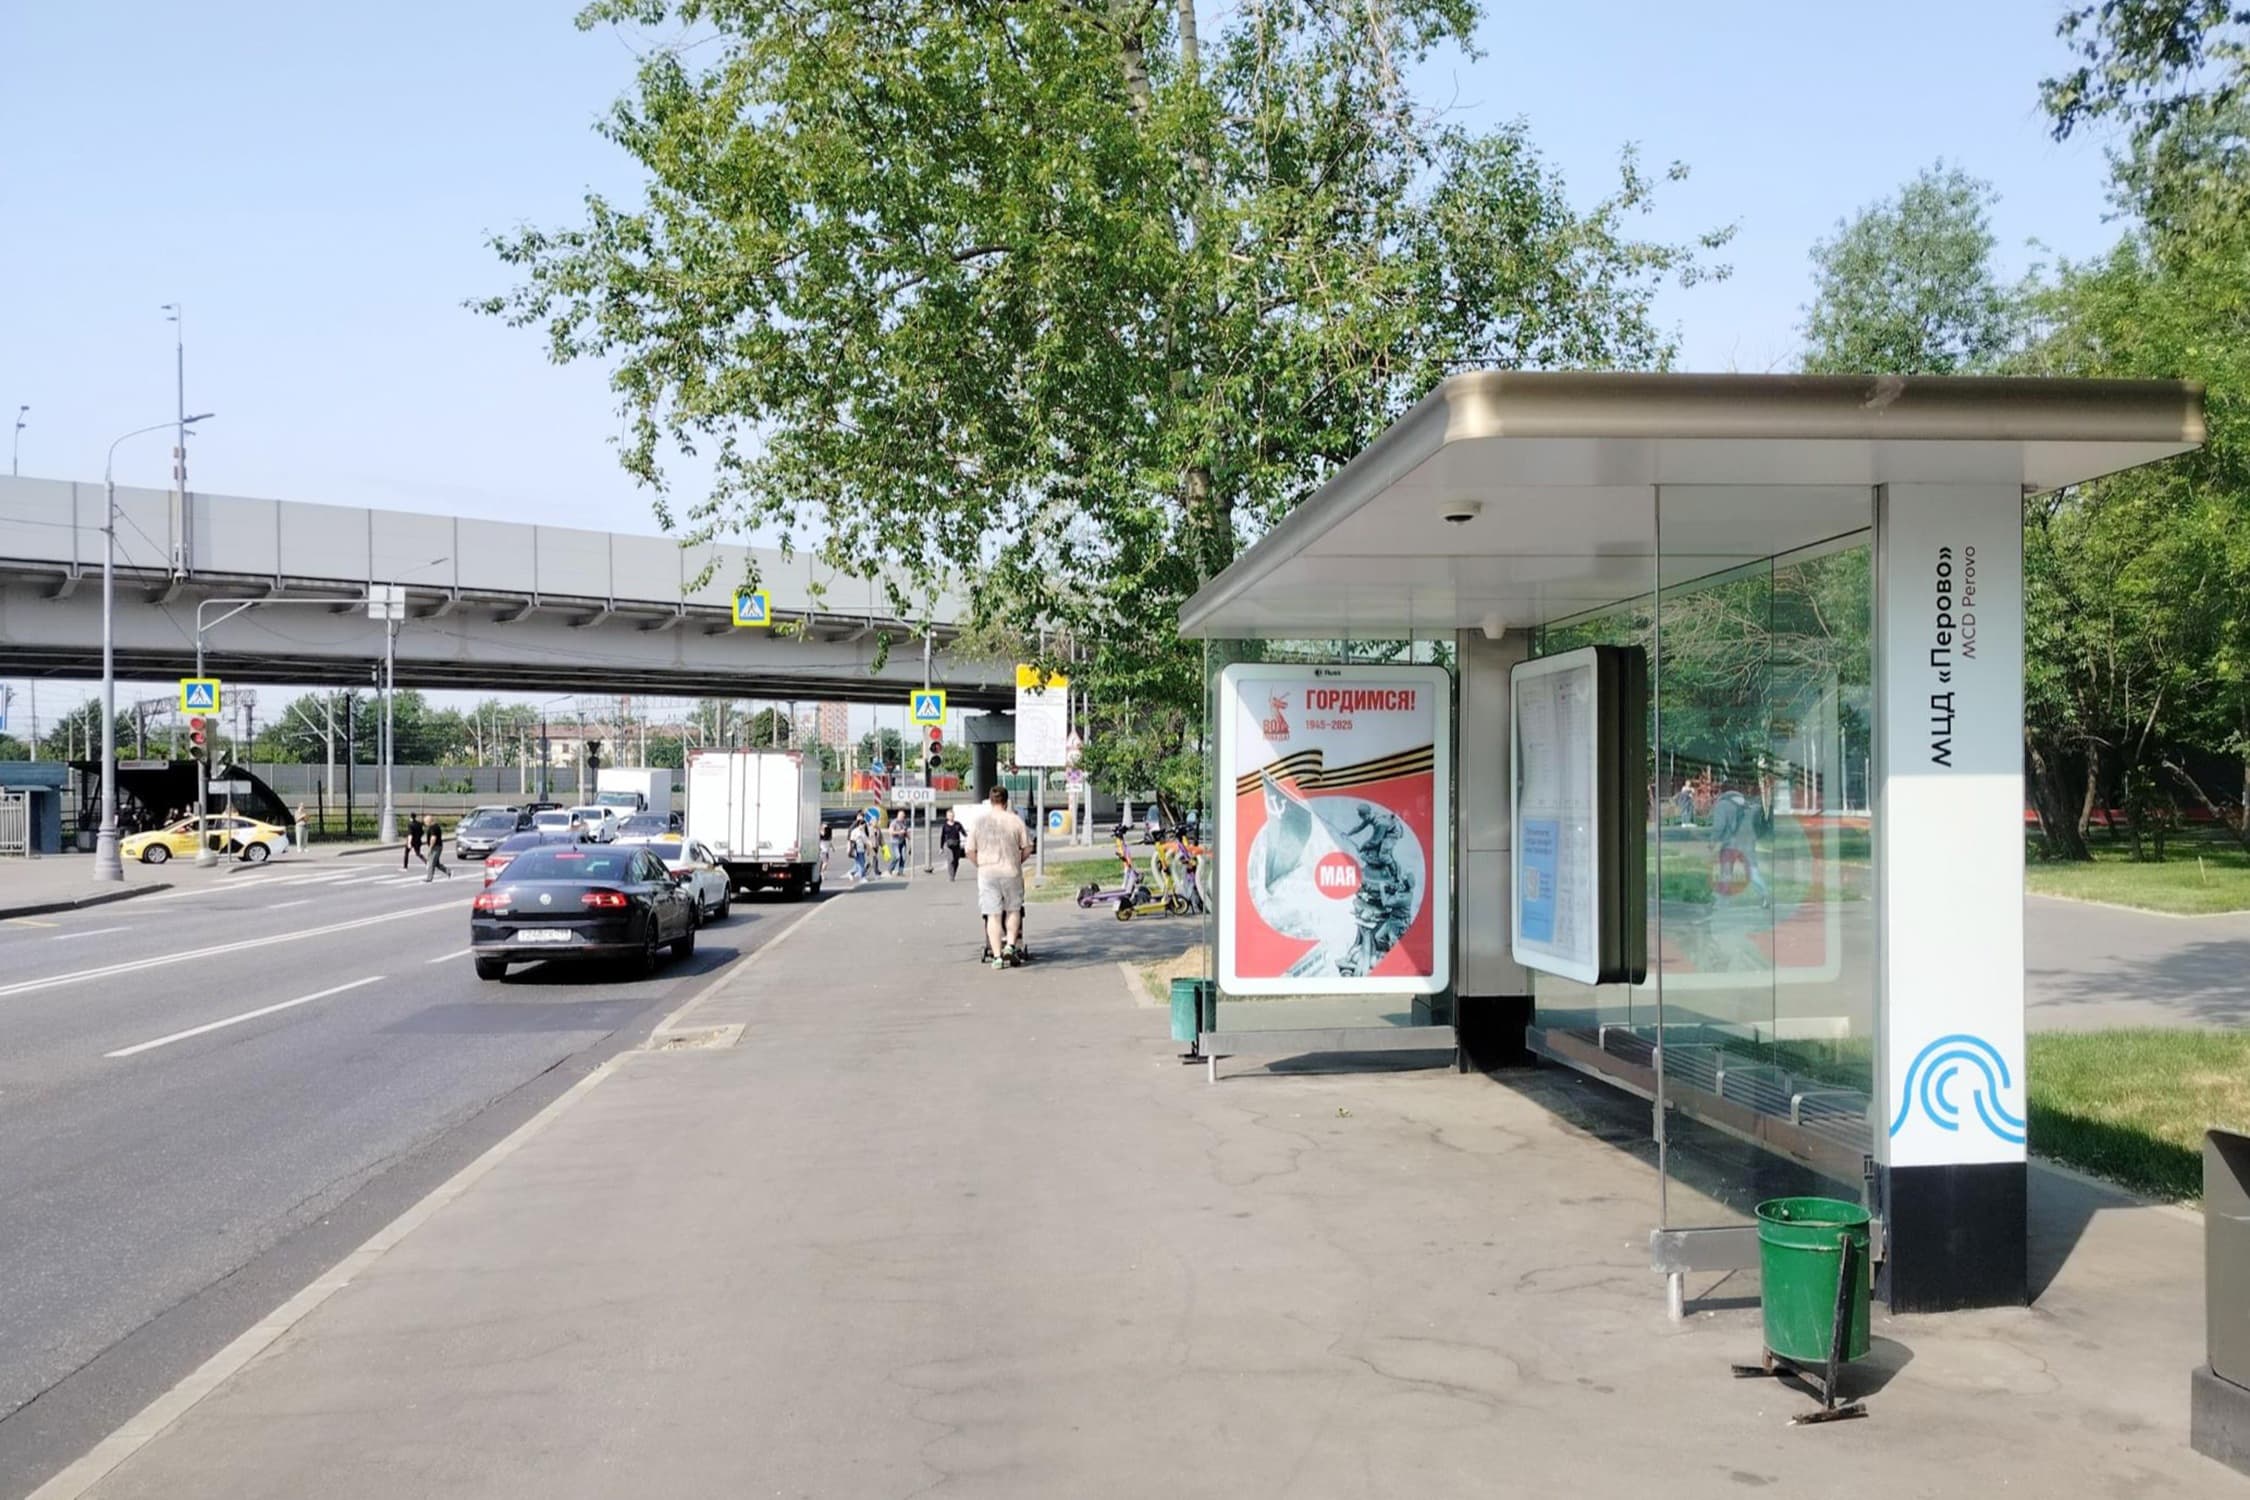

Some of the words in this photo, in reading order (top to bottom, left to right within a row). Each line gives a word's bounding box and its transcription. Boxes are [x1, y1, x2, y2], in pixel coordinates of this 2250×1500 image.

[1961, 546, 1976, 607] Perovo
[1930, 547, 1956, 683] «Перово»
[1961, 612, 1976, 659] MCD
[1306, 689, 1416, 713] ГОРДИМСЯ!
[1930, 692, 1955, 768] МЦД
[897, 790, 929, 800] СТОП
[1320, 865, 1356, 887] МАЯ
